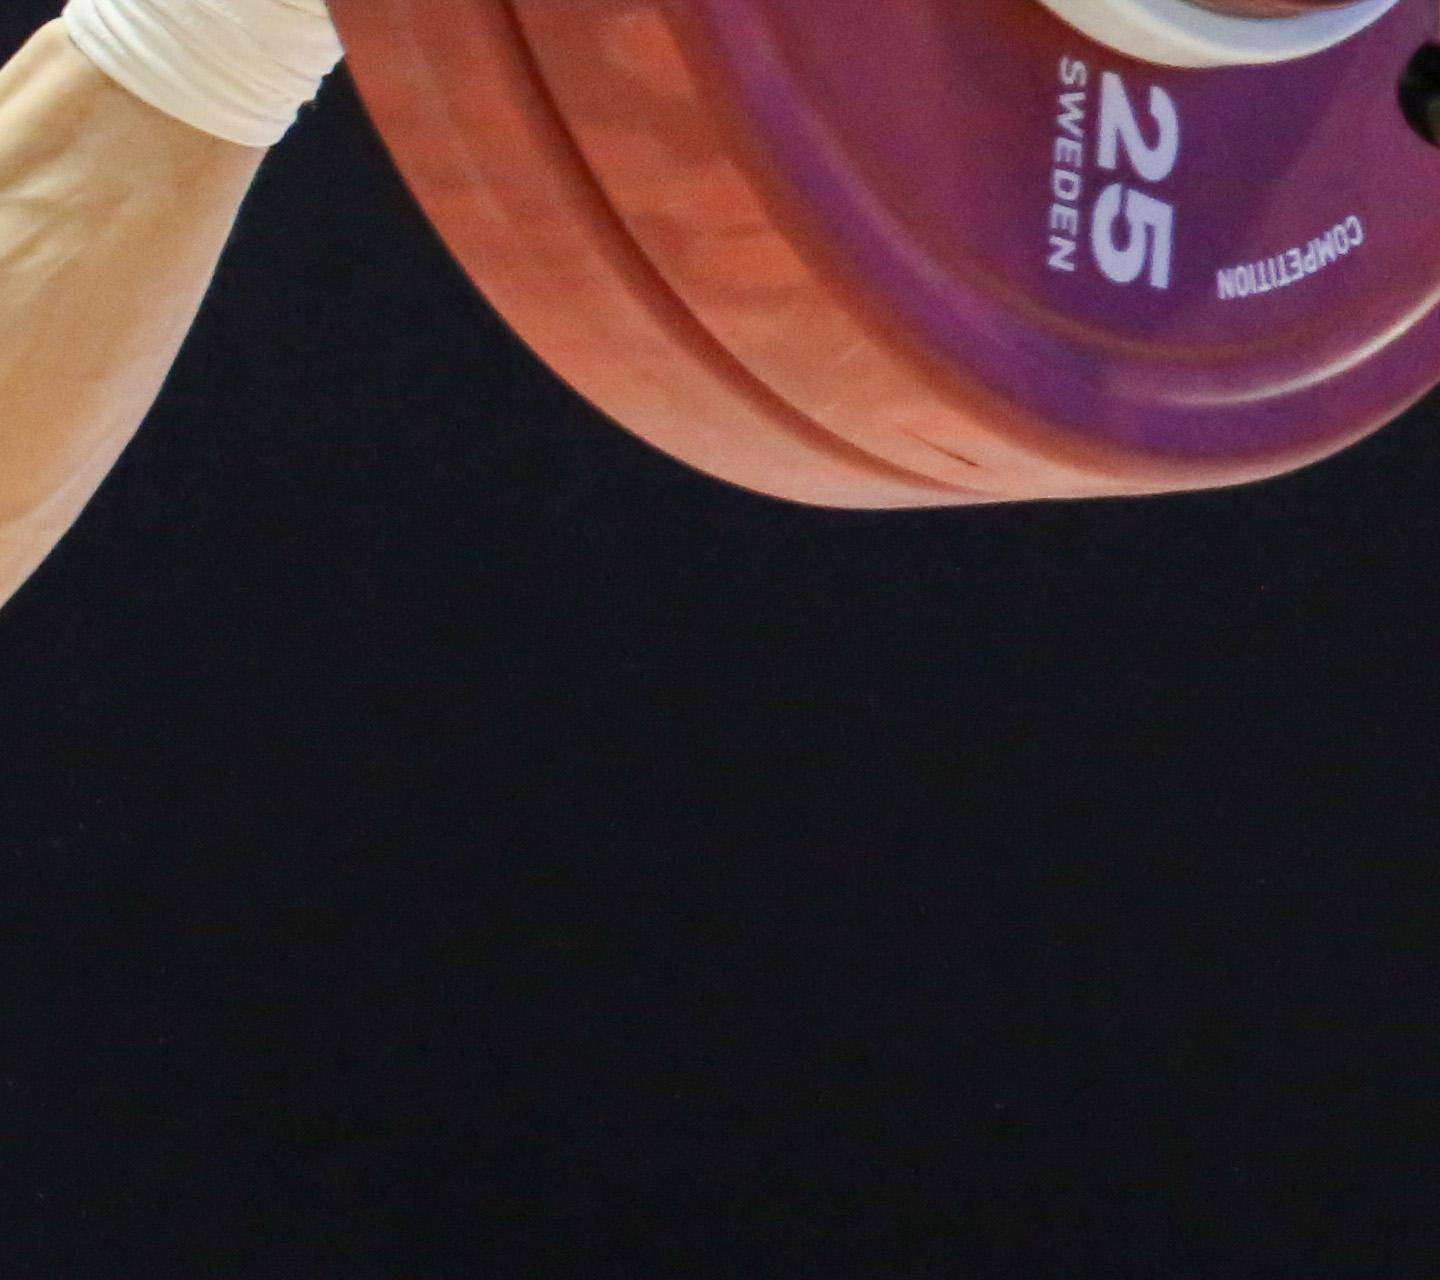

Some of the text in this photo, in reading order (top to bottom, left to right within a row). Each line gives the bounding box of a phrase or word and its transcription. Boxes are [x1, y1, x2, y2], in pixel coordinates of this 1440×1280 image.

[1047, 55, 1088, 273] SWEDEN
[1091, 71, 1180, 290] 25
[1216, 215, 1365, 300] COMPETITION
